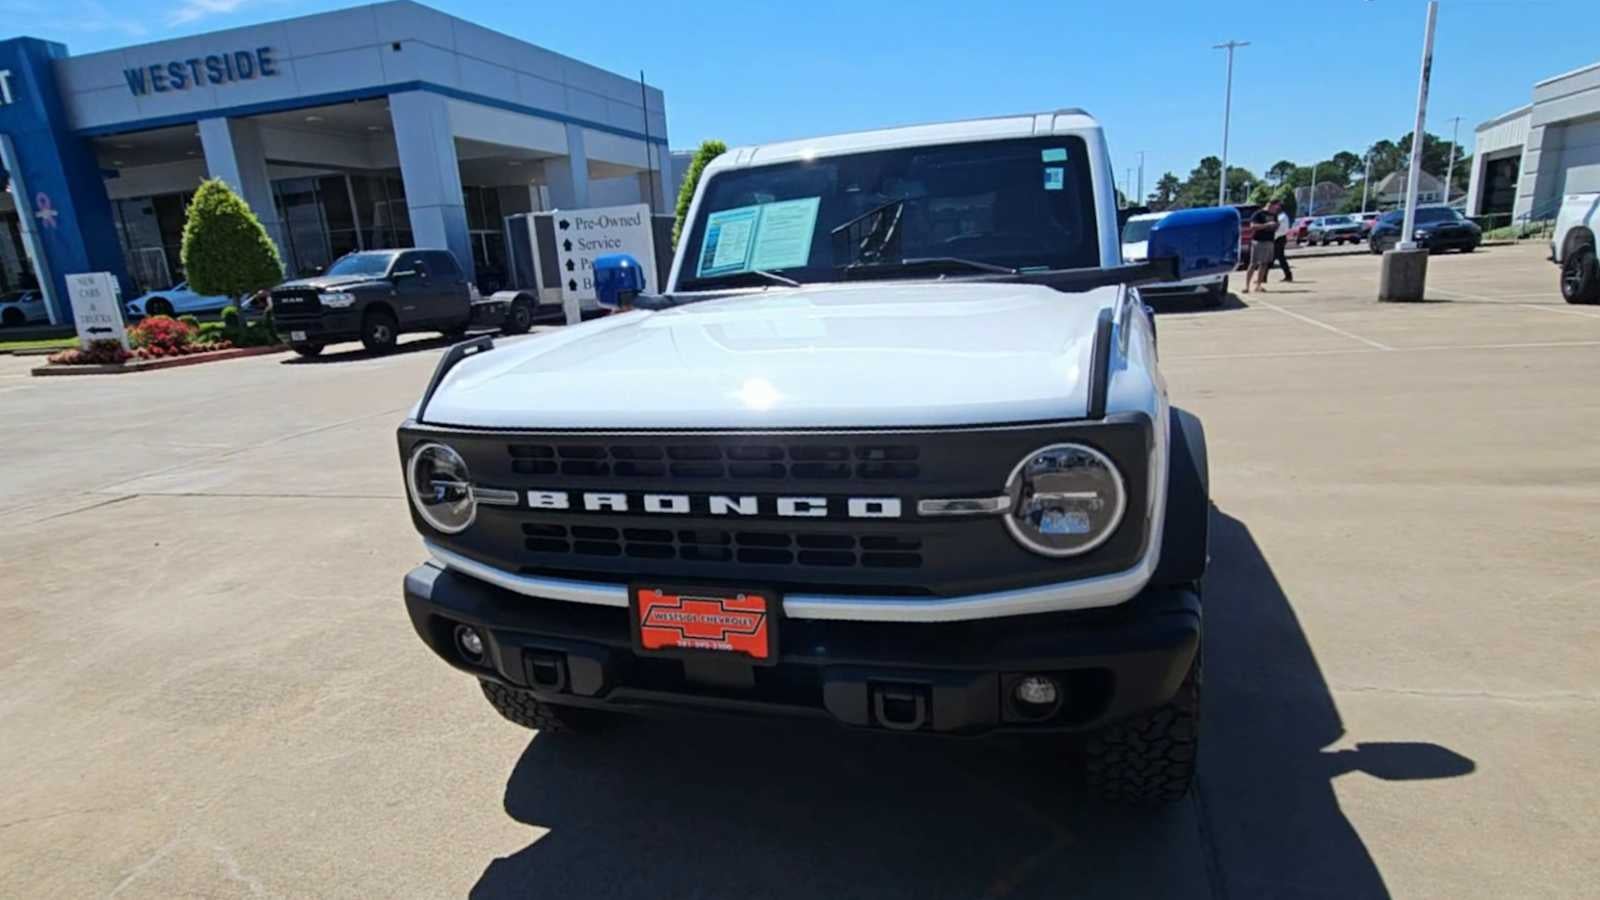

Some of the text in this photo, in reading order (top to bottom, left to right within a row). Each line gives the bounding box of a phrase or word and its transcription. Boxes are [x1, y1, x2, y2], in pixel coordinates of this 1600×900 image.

[124, 46, 276, 96] WESTSIDE
[575, 212, 641, 230] Pre-Owned
[578, 235, 621, 250] Service
[79, 289, 100, 298] CARS
[80, 314, 112, 323] TRUCKS
[527, 491, 901, 517] BRONCO
[655, 613, 752, 626] WESTSIDE CHEVROLET
